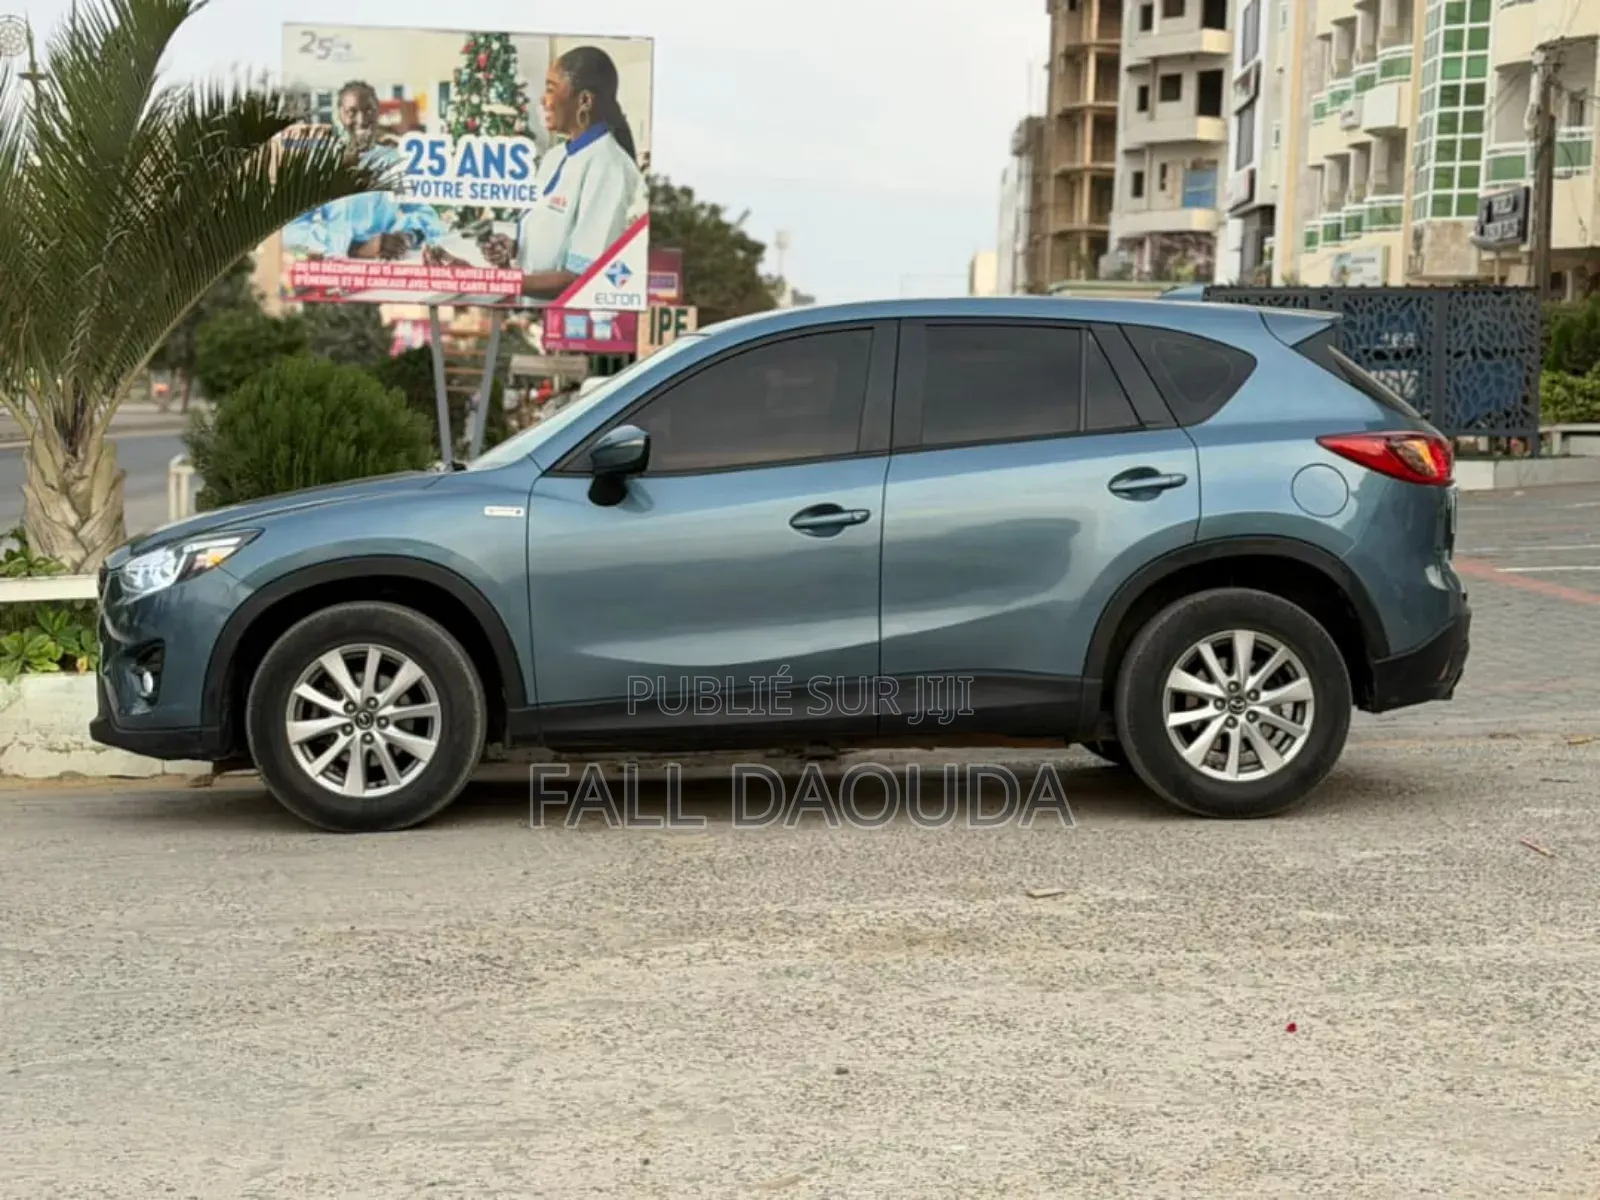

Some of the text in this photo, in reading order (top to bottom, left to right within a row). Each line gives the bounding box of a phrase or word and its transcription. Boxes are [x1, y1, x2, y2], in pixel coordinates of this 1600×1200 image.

[405, 138, 530, 180] 25 ANS
[412, 180, 463, 198] VOTRE
[469, 182, 537, 201] SERVICE
